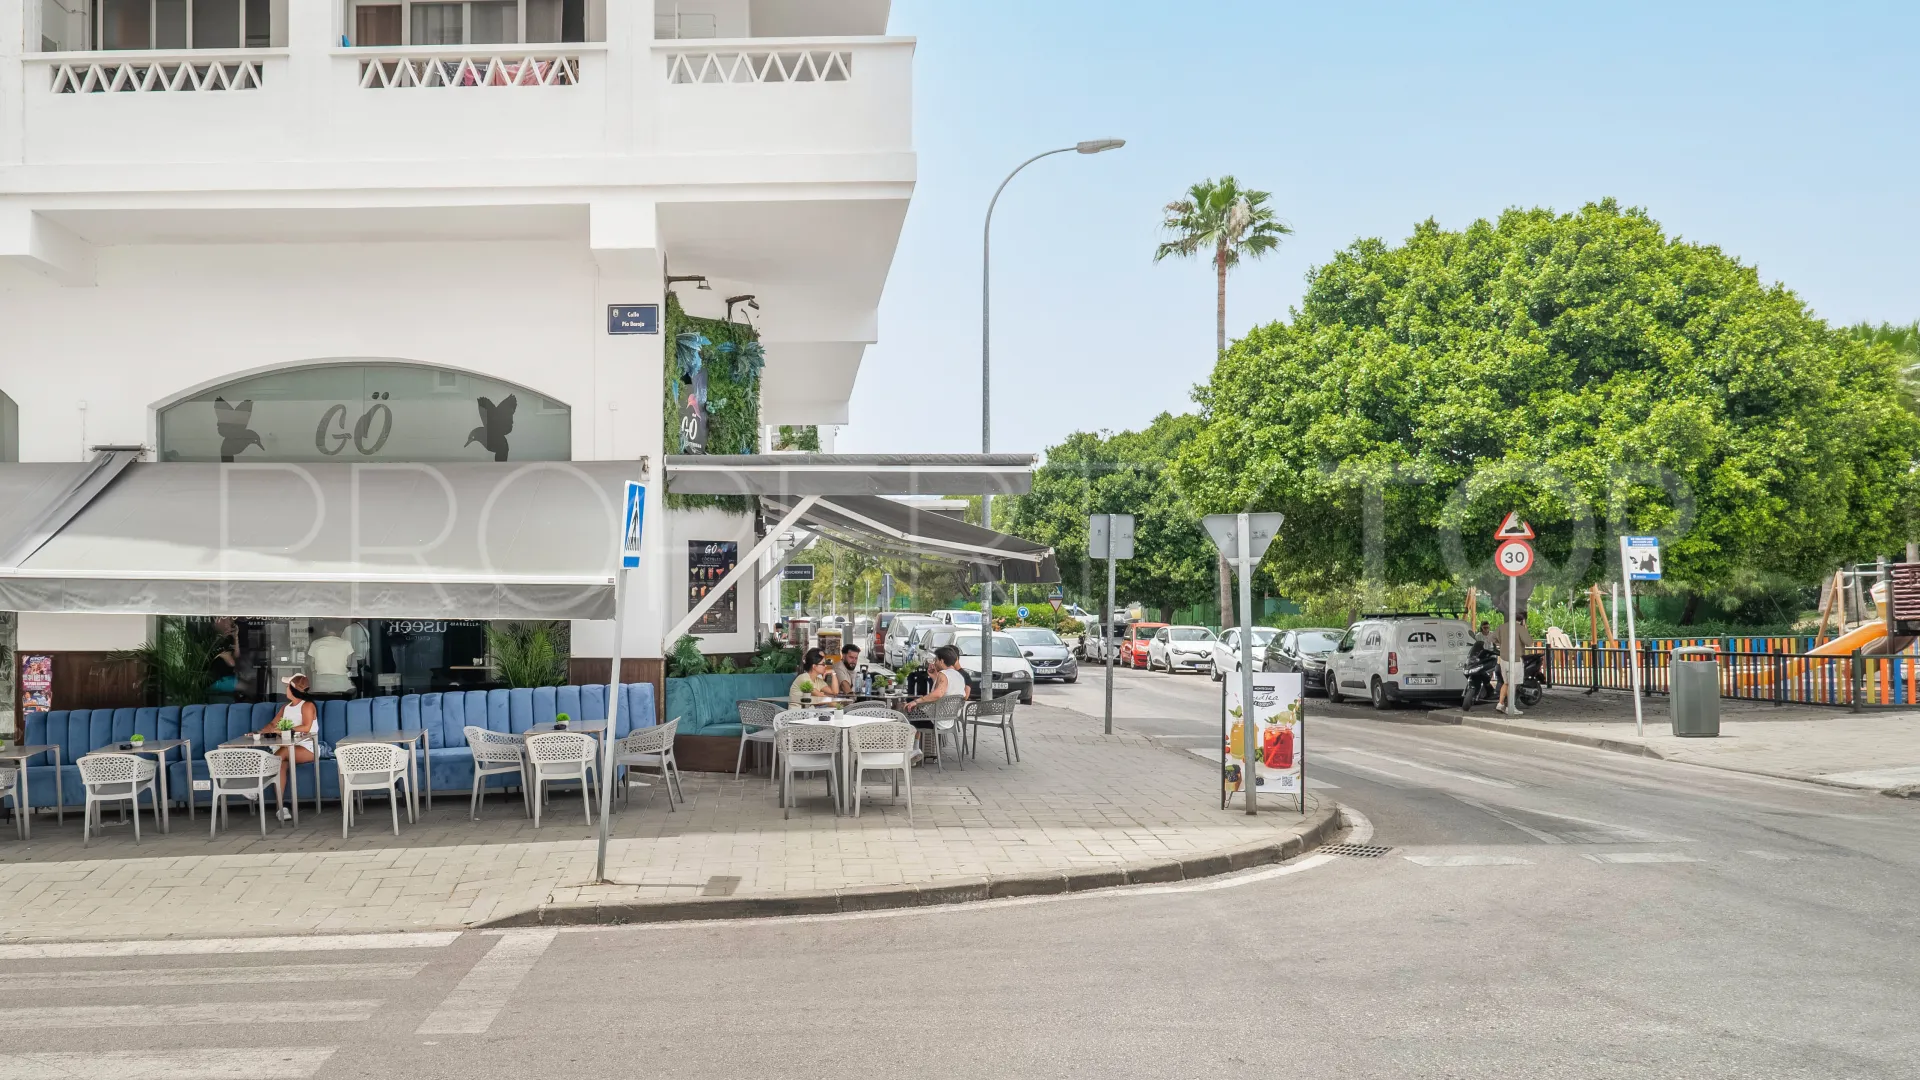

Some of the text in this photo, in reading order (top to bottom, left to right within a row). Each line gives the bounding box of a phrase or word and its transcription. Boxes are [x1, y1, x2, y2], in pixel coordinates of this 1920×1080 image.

[315, 391, 393, 456] GÖ
[1504, 551, 1525, 564] 30
[1408, 632, 1437, 643] GTA
